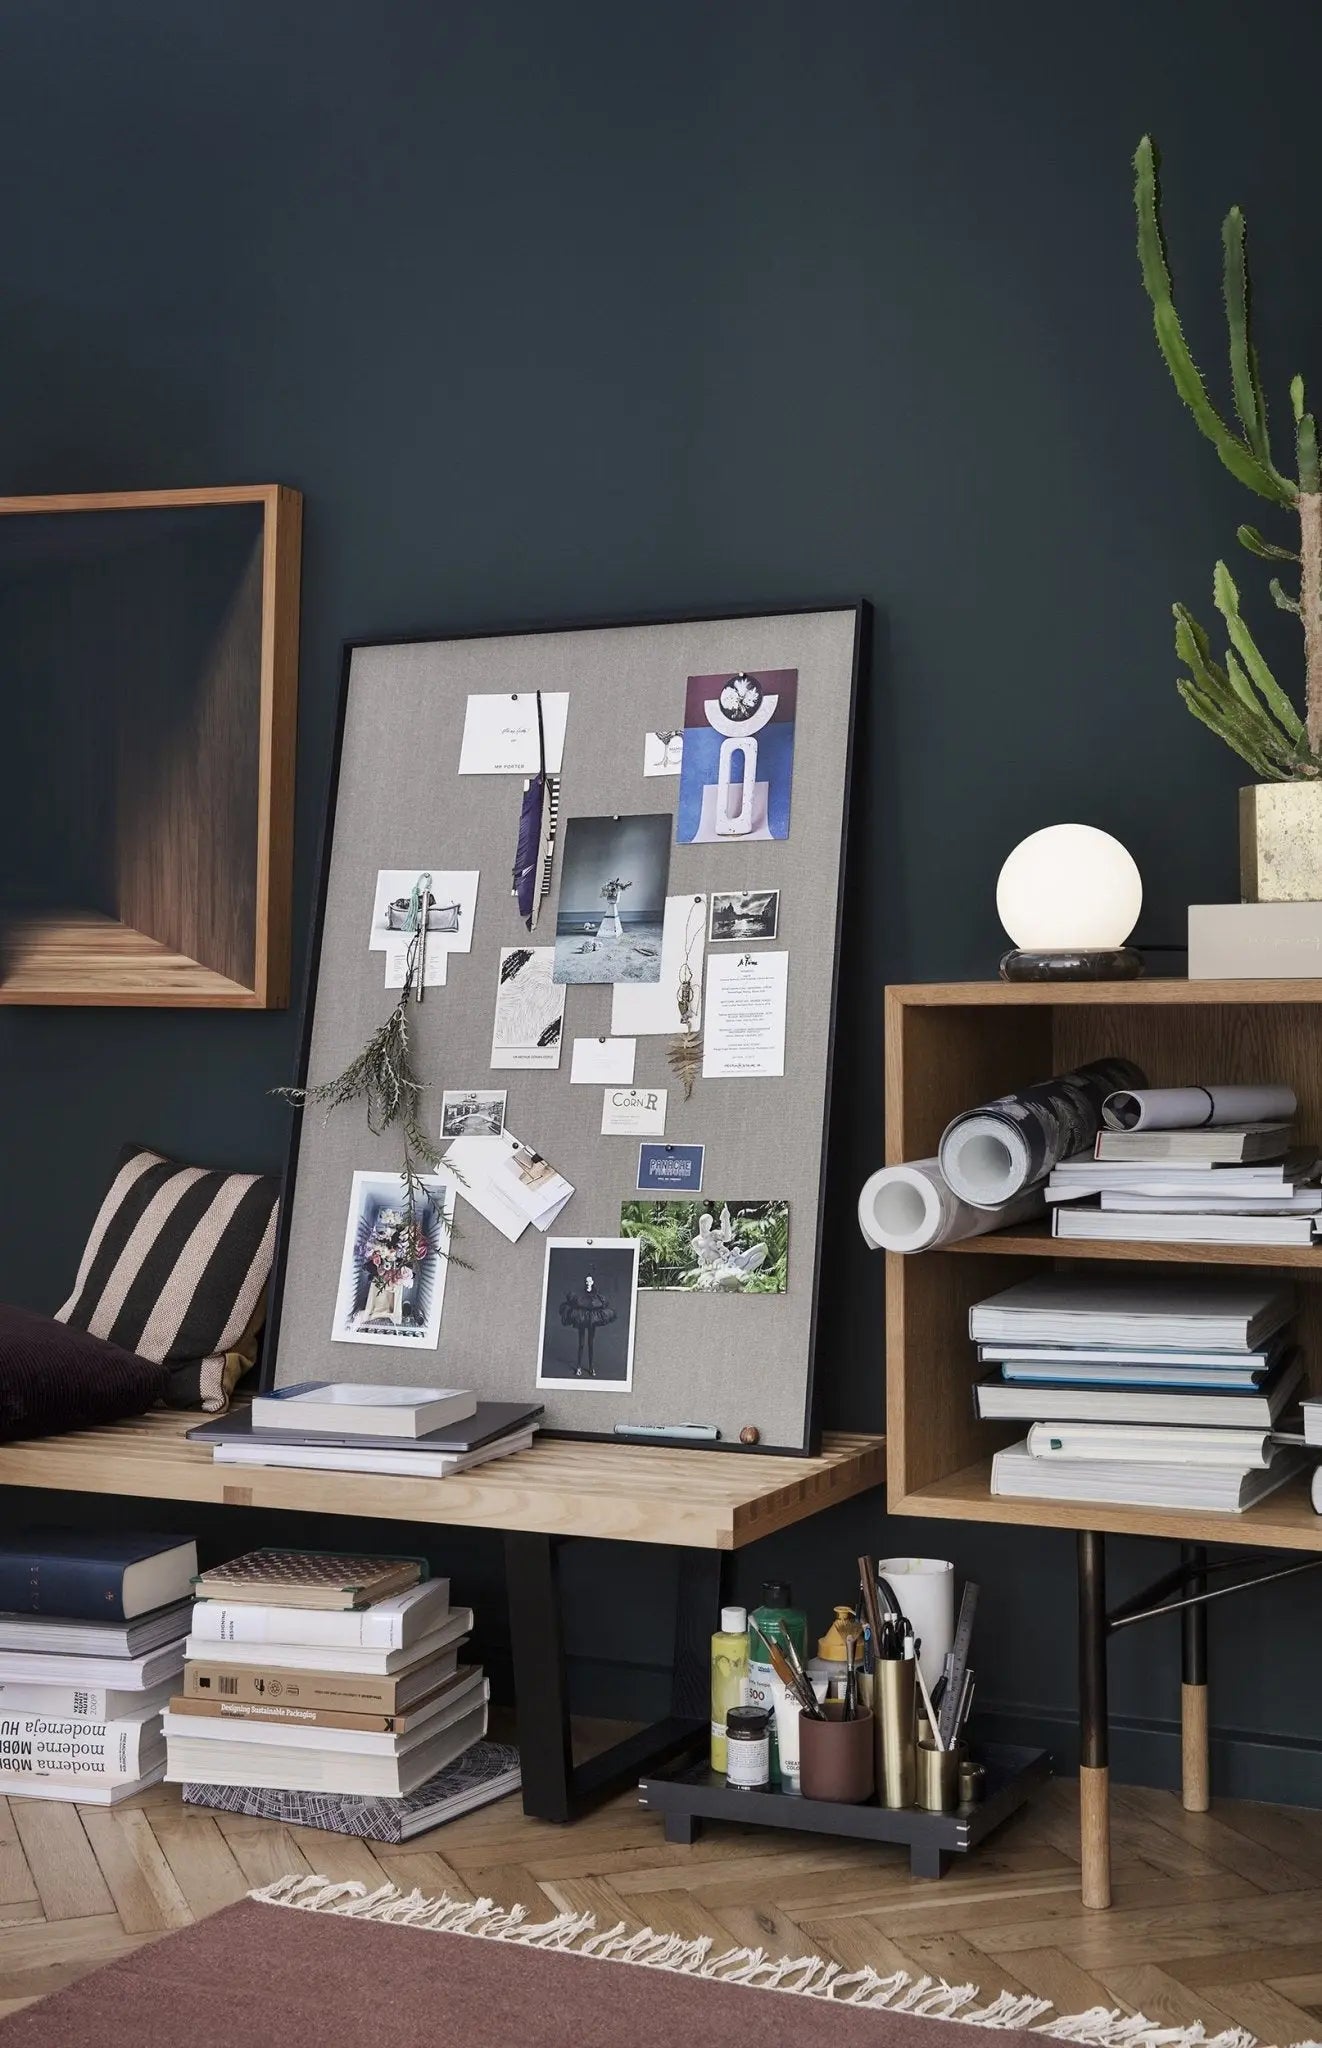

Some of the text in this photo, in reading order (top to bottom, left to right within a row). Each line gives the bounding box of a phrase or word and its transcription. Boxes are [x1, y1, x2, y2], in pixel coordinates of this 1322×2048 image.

[90, 1694, 98, 1715] 2009
[220, 1703, 251, 1715] Designing
[251, 1705, 286, 1717] Sustainable
[286, 1708, 317, 1721] Packaging
[25, 1719, 107, 1739] moderneja
[37, 1741, 105, 1757] moderne
[37, 1759, 105, 1774] moderna
